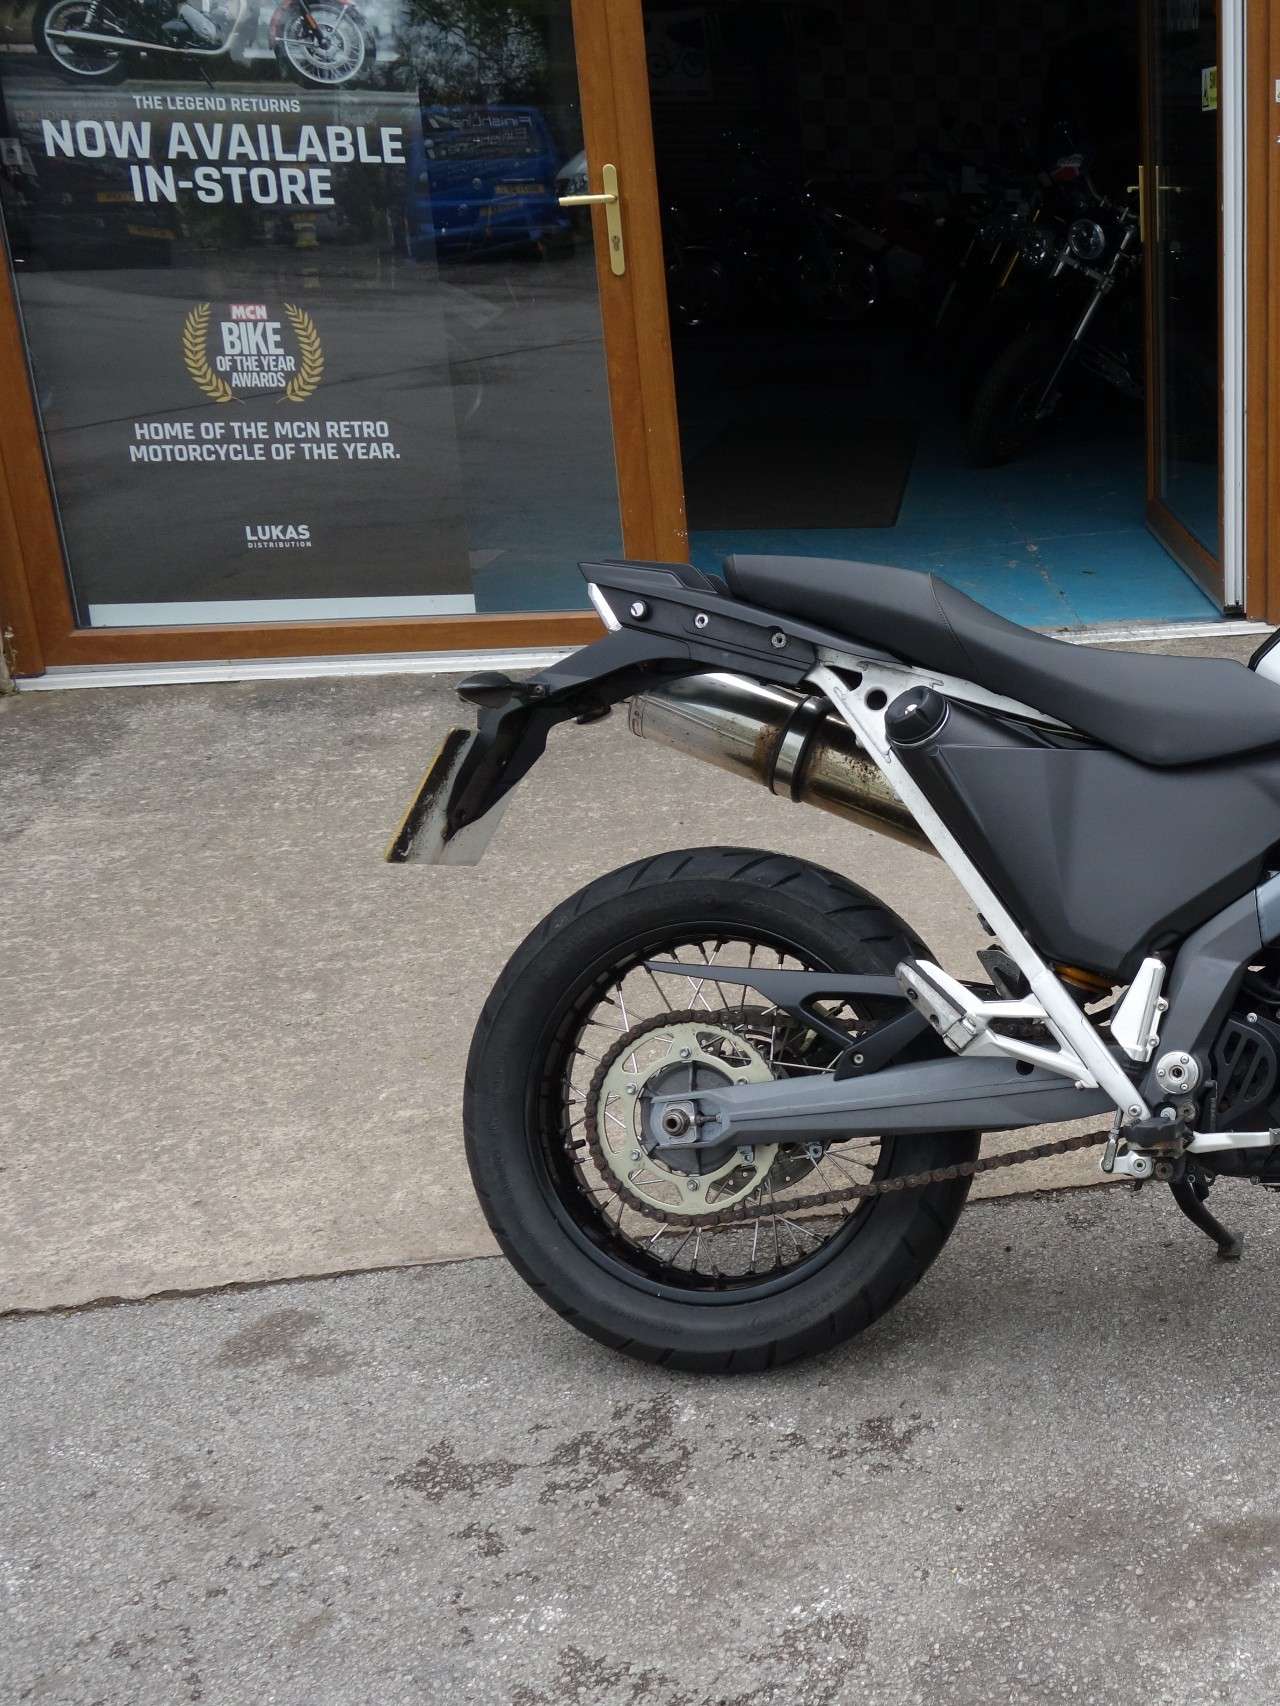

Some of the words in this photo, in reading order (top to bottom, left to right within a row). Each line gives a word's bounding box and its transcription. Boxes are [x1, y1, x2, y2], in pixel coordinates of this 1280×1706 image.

[133, 95, 163, 110] THE
[167, 97, 226, 112] LEGEND
[231, 98, 300, 113] RETURNS
[41, 119, 151, 158] NOW
[168, 123, 406, 164] AVAILABLE
[130, 165, 335, 205] IN-STORE
[231, 305, 268, 319] MCN
[221, 322, 284, 355] BIKE
[216, 356, 233, 371] OF
[235, 356, 262, 371] THE
[262, 356, 296, 371] YEAR
[231, 372, 286, 387] AWARDS
[134, 422, 194, 440] HOME
[200, 422, 225, 439] OF
[230, 422, 269, 439] THE
[273, 421, 321, 439] MCN
[325, 421, 389, 438] RETRO
[129, 444, 266, 462] MOTORCYCLE
[271, 443, 296, 461] OF
[300, 443, 338, 460] THE
[342, 442, 400, 460] YEAR.
[245, 524, 310, 540] LUKAS
[248, 541, 312, 549] DISTRIBUTION
